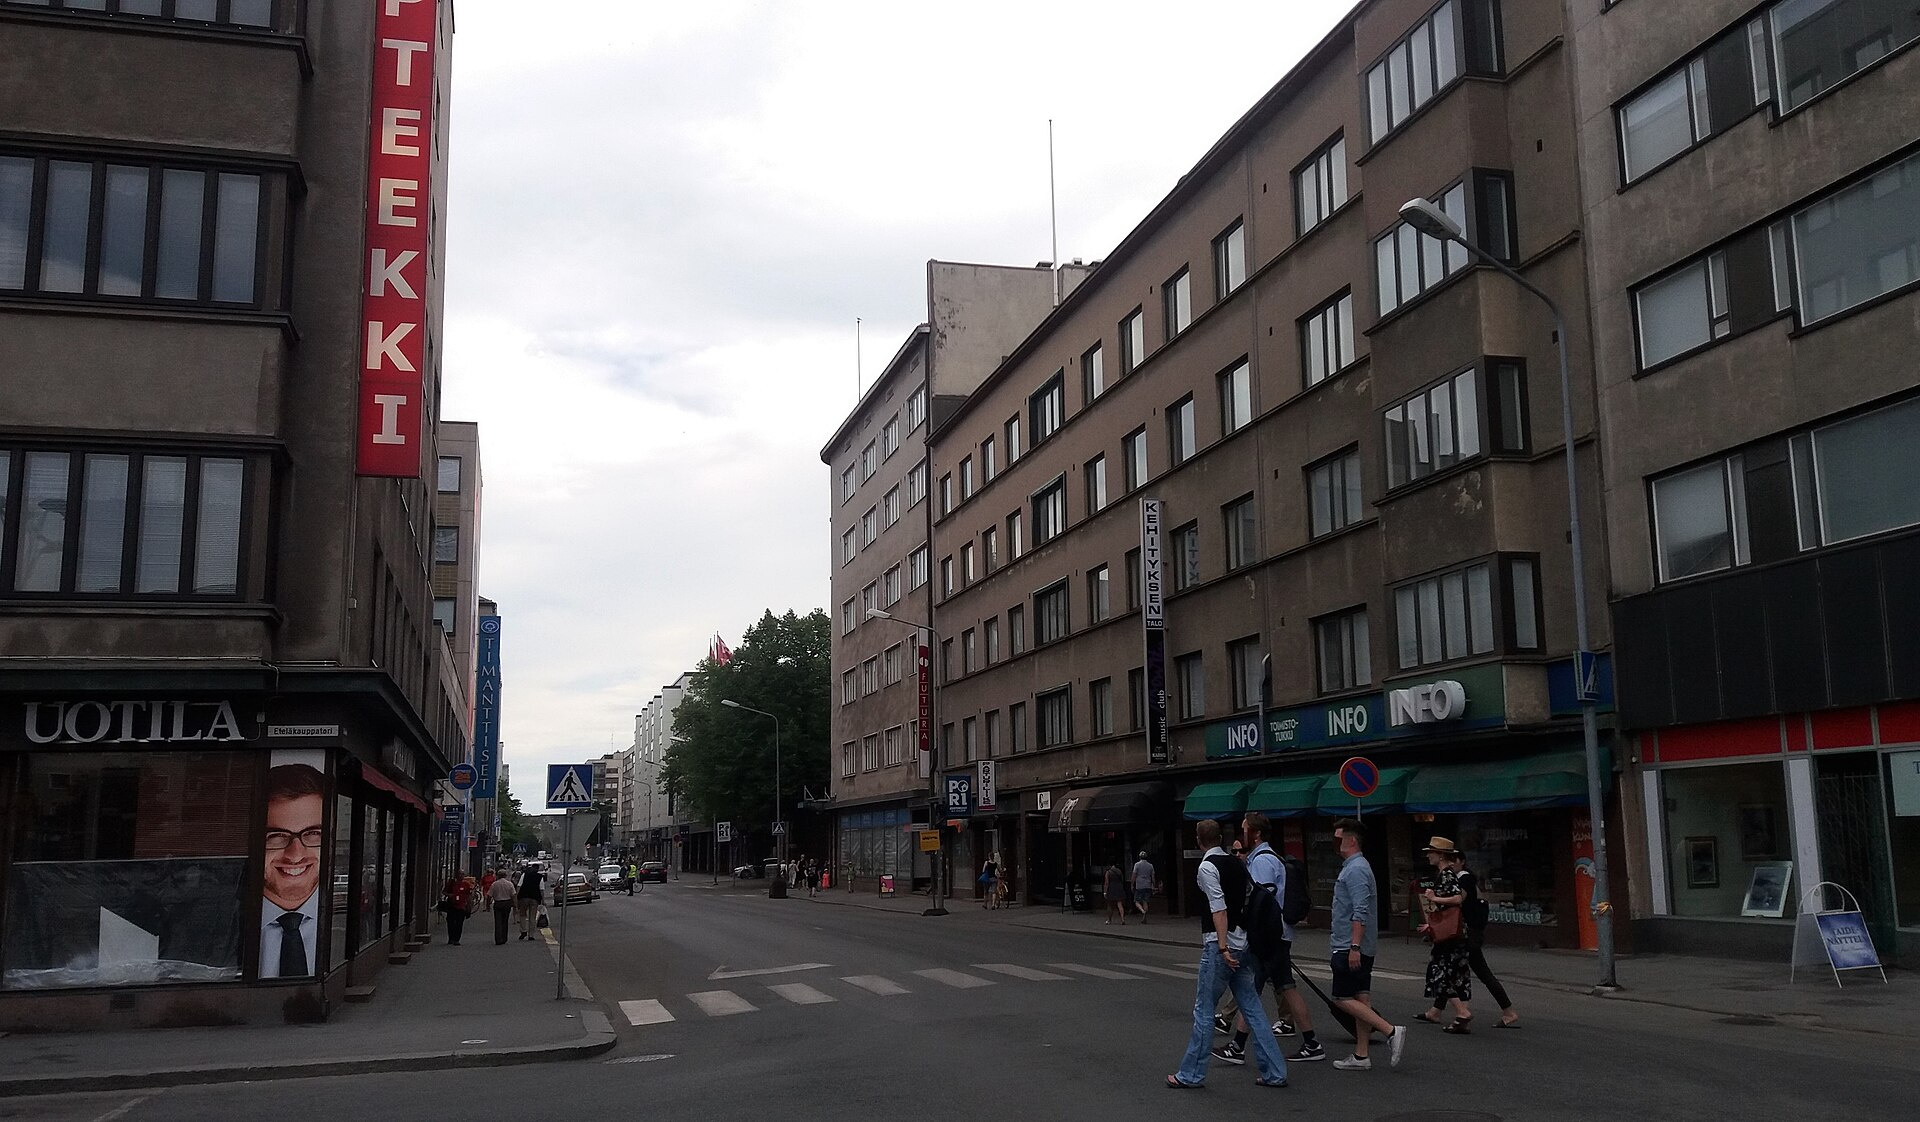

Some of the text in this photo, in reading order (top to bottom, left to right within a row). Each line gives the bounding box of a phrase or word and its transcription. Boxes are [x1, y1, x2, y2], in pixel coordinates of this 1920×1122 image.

[1145, 503, 1161, 615] KEHITYKSEN
[1146, 620, 1163, 628] TALO
[23, 700, 245, 744] UOTILA
[480, 638, 496, 790] TIMANTTISET
[920, 672, 929, 740] FUTURA
[1156, 689, 1167, 743] music club
[1269, 719, 1299, 733] TOIMISTO-
[1328, 704, 1368, 737] INFO
[1389, 680, 1467, 728] INFO
[1227, 723, 1259, 750] INFO
[1274, 730, 1295, 742] TUKKU
